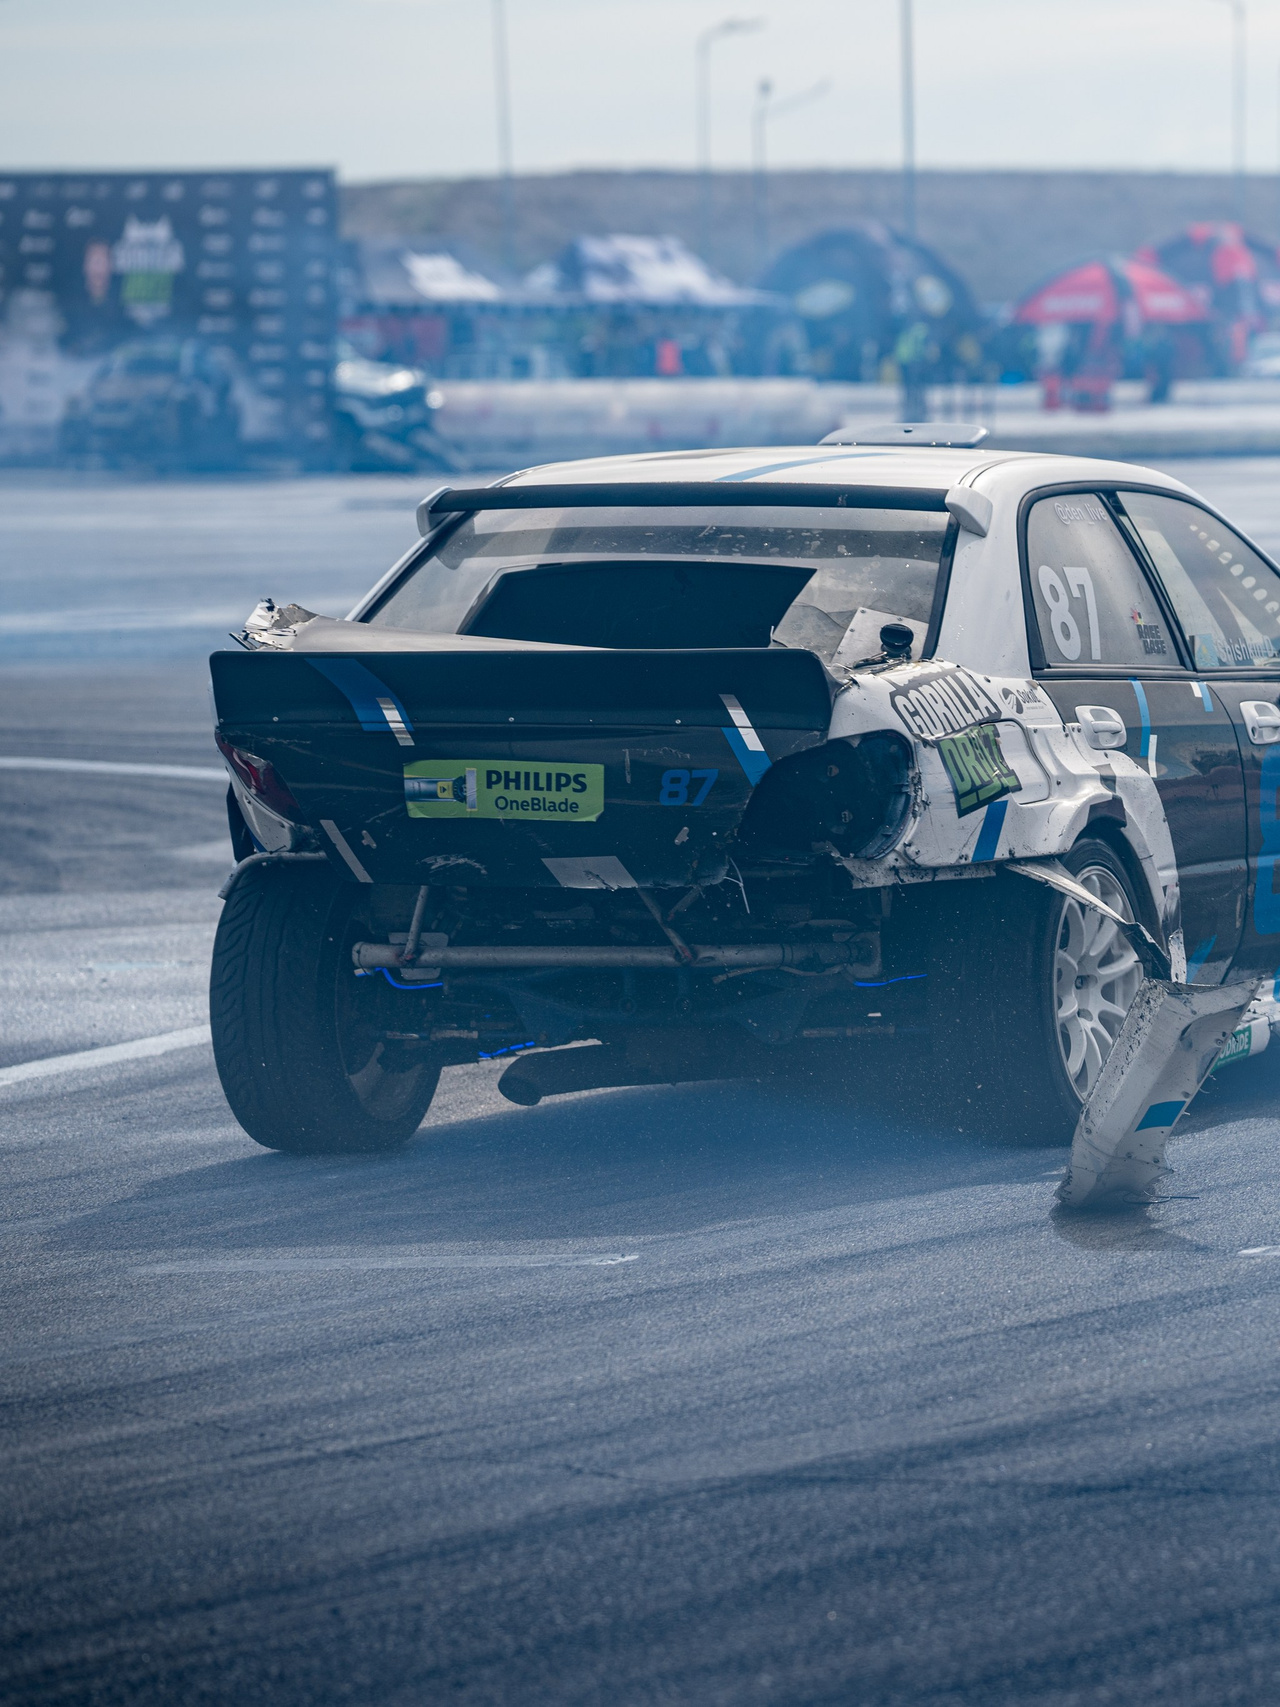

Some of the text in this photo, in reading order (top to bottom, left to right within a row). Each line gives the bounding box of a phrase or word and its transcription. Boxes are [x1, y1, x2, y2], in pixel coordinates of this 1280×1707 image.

[1038, 564, 1102, 661] 87
[894, 670, 998, 738] GORILLA
[485, 769, 588, 793] PHILIPS
[658, 768, 719, 807] 87
[494, 795, 580, 814] OneBlade
